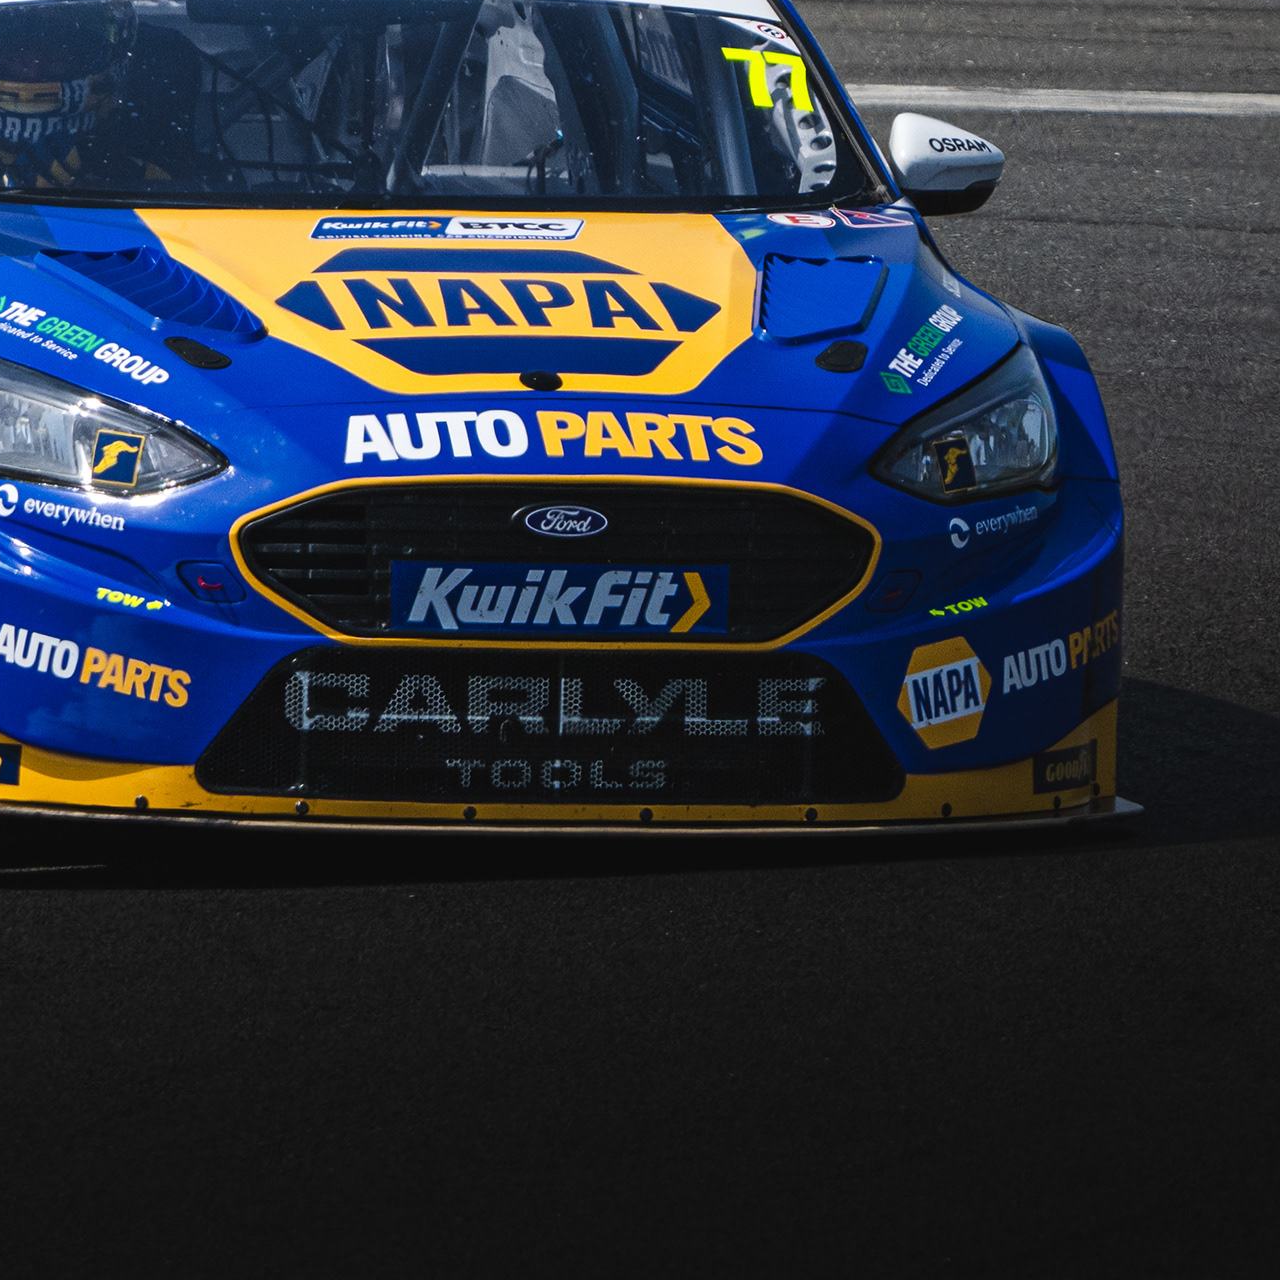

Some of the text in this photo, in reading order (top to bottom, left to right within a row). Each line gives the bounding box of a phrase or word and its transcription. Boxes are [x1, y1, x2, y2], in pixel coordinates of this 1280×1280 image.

[721, 46, 814, 113] 77
[928, 137, 992, 153] OSRAM
[458, 221, 568, 232] BTCC
[342, 277, 665, 331] NAPA
[29, 332, 43, 344] to
[41, 339, 78, 361] Service
[36, 316, 105, 353] GREEN
[93, 342, 170, 385] GROUP
[888, 347, 924, 378] THE
[907, 322, 946, 357] GREEN
[928, 304, 964, 333] GROUP
[917, 357, 946, 387] Dedicated
[941, 338, 963, 356] Service
[344, 409, 762, 466] AUTO PARTS
[23, 496, 125, 532] everywhen
[540, 508, 592, 532] Ford
[975, 504, 1038, 535] everywhen
[96, 587, 146, 608] TOW
[944, 596, 988, 615] TOW
[1002, 609, 1120, 696] AUTO PARTS
[79, 647, 192, 708] PARTS
[912, 663, 980, 723] NAPA
[284, 671, 827, 736] CARLYLE
[445, 758, 669, 790] TOOLS
